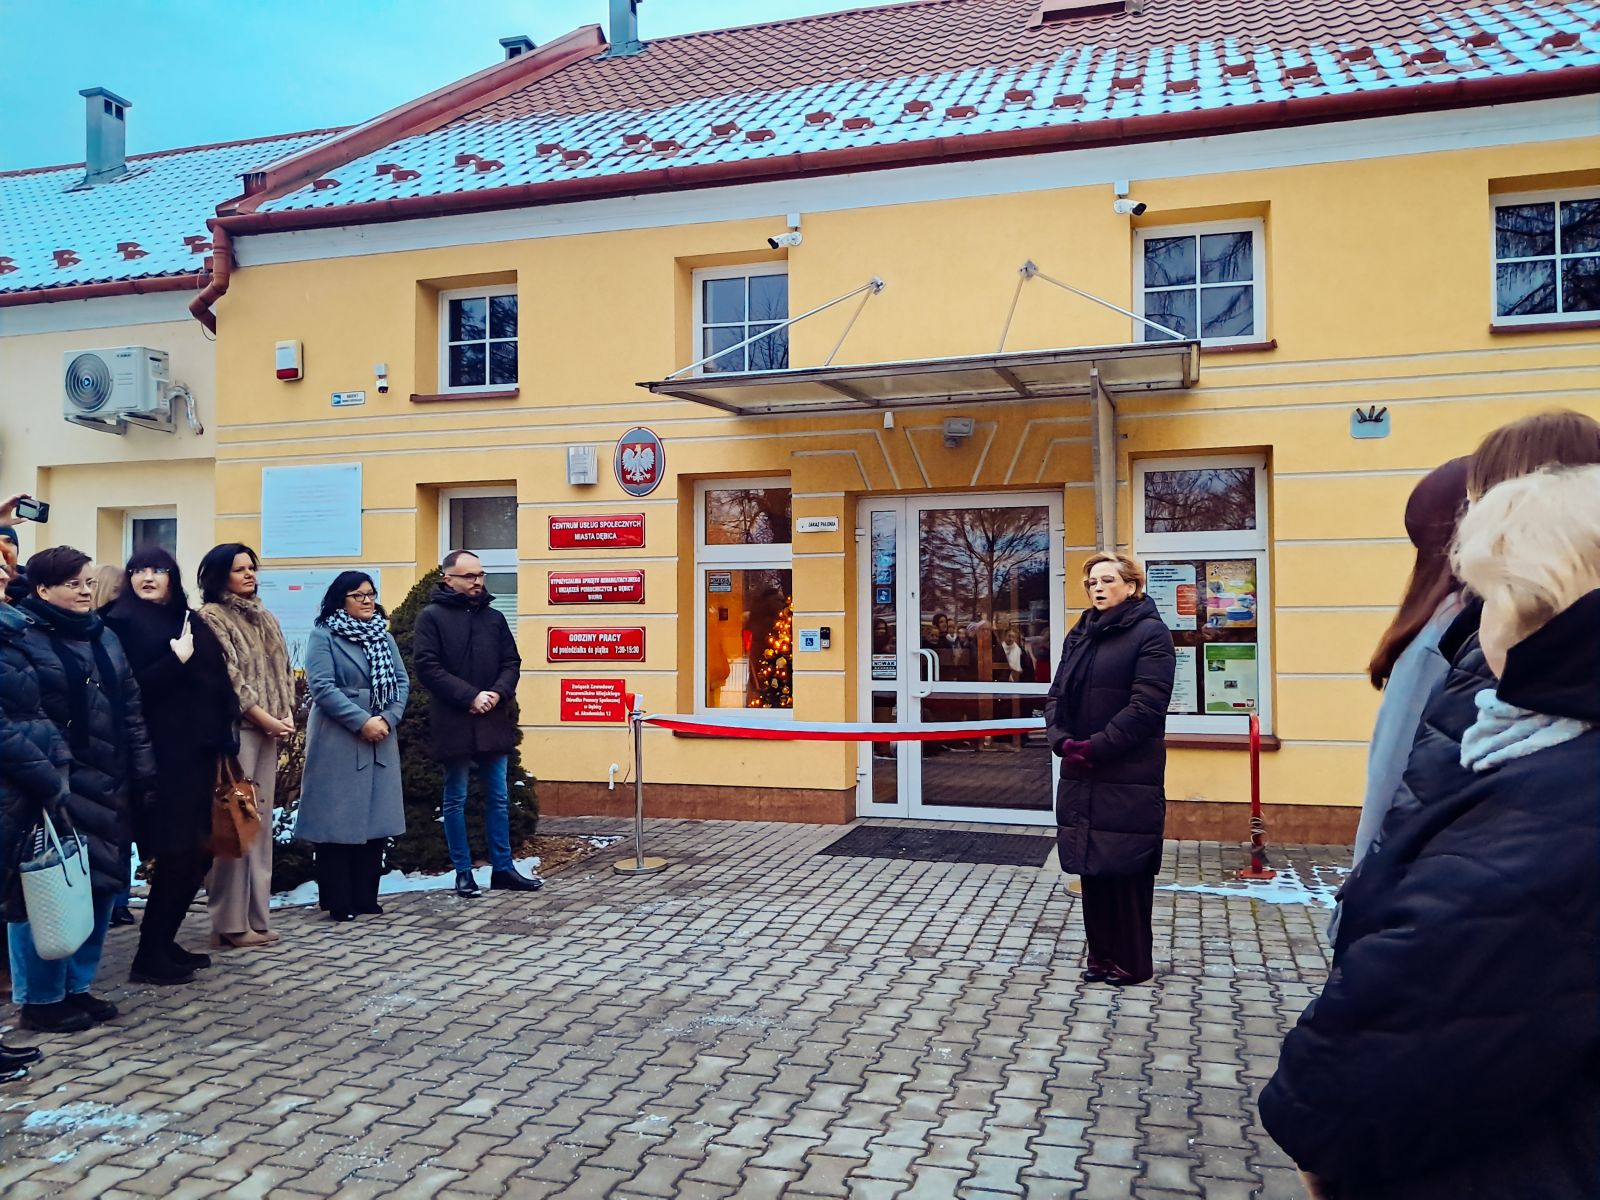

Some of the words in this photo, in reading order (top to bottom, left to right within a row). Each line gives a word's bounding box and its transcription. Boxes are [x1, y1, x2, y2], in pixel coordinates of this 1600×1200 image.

[596, 532, 617, 541] DĘBICA
[569, 634, 597, 642] GODZINY
[599, 634, 621, 642] PRACY
[559, 646, 586, 655] poniedziałku
[595, 646, 609, 655] piątku
